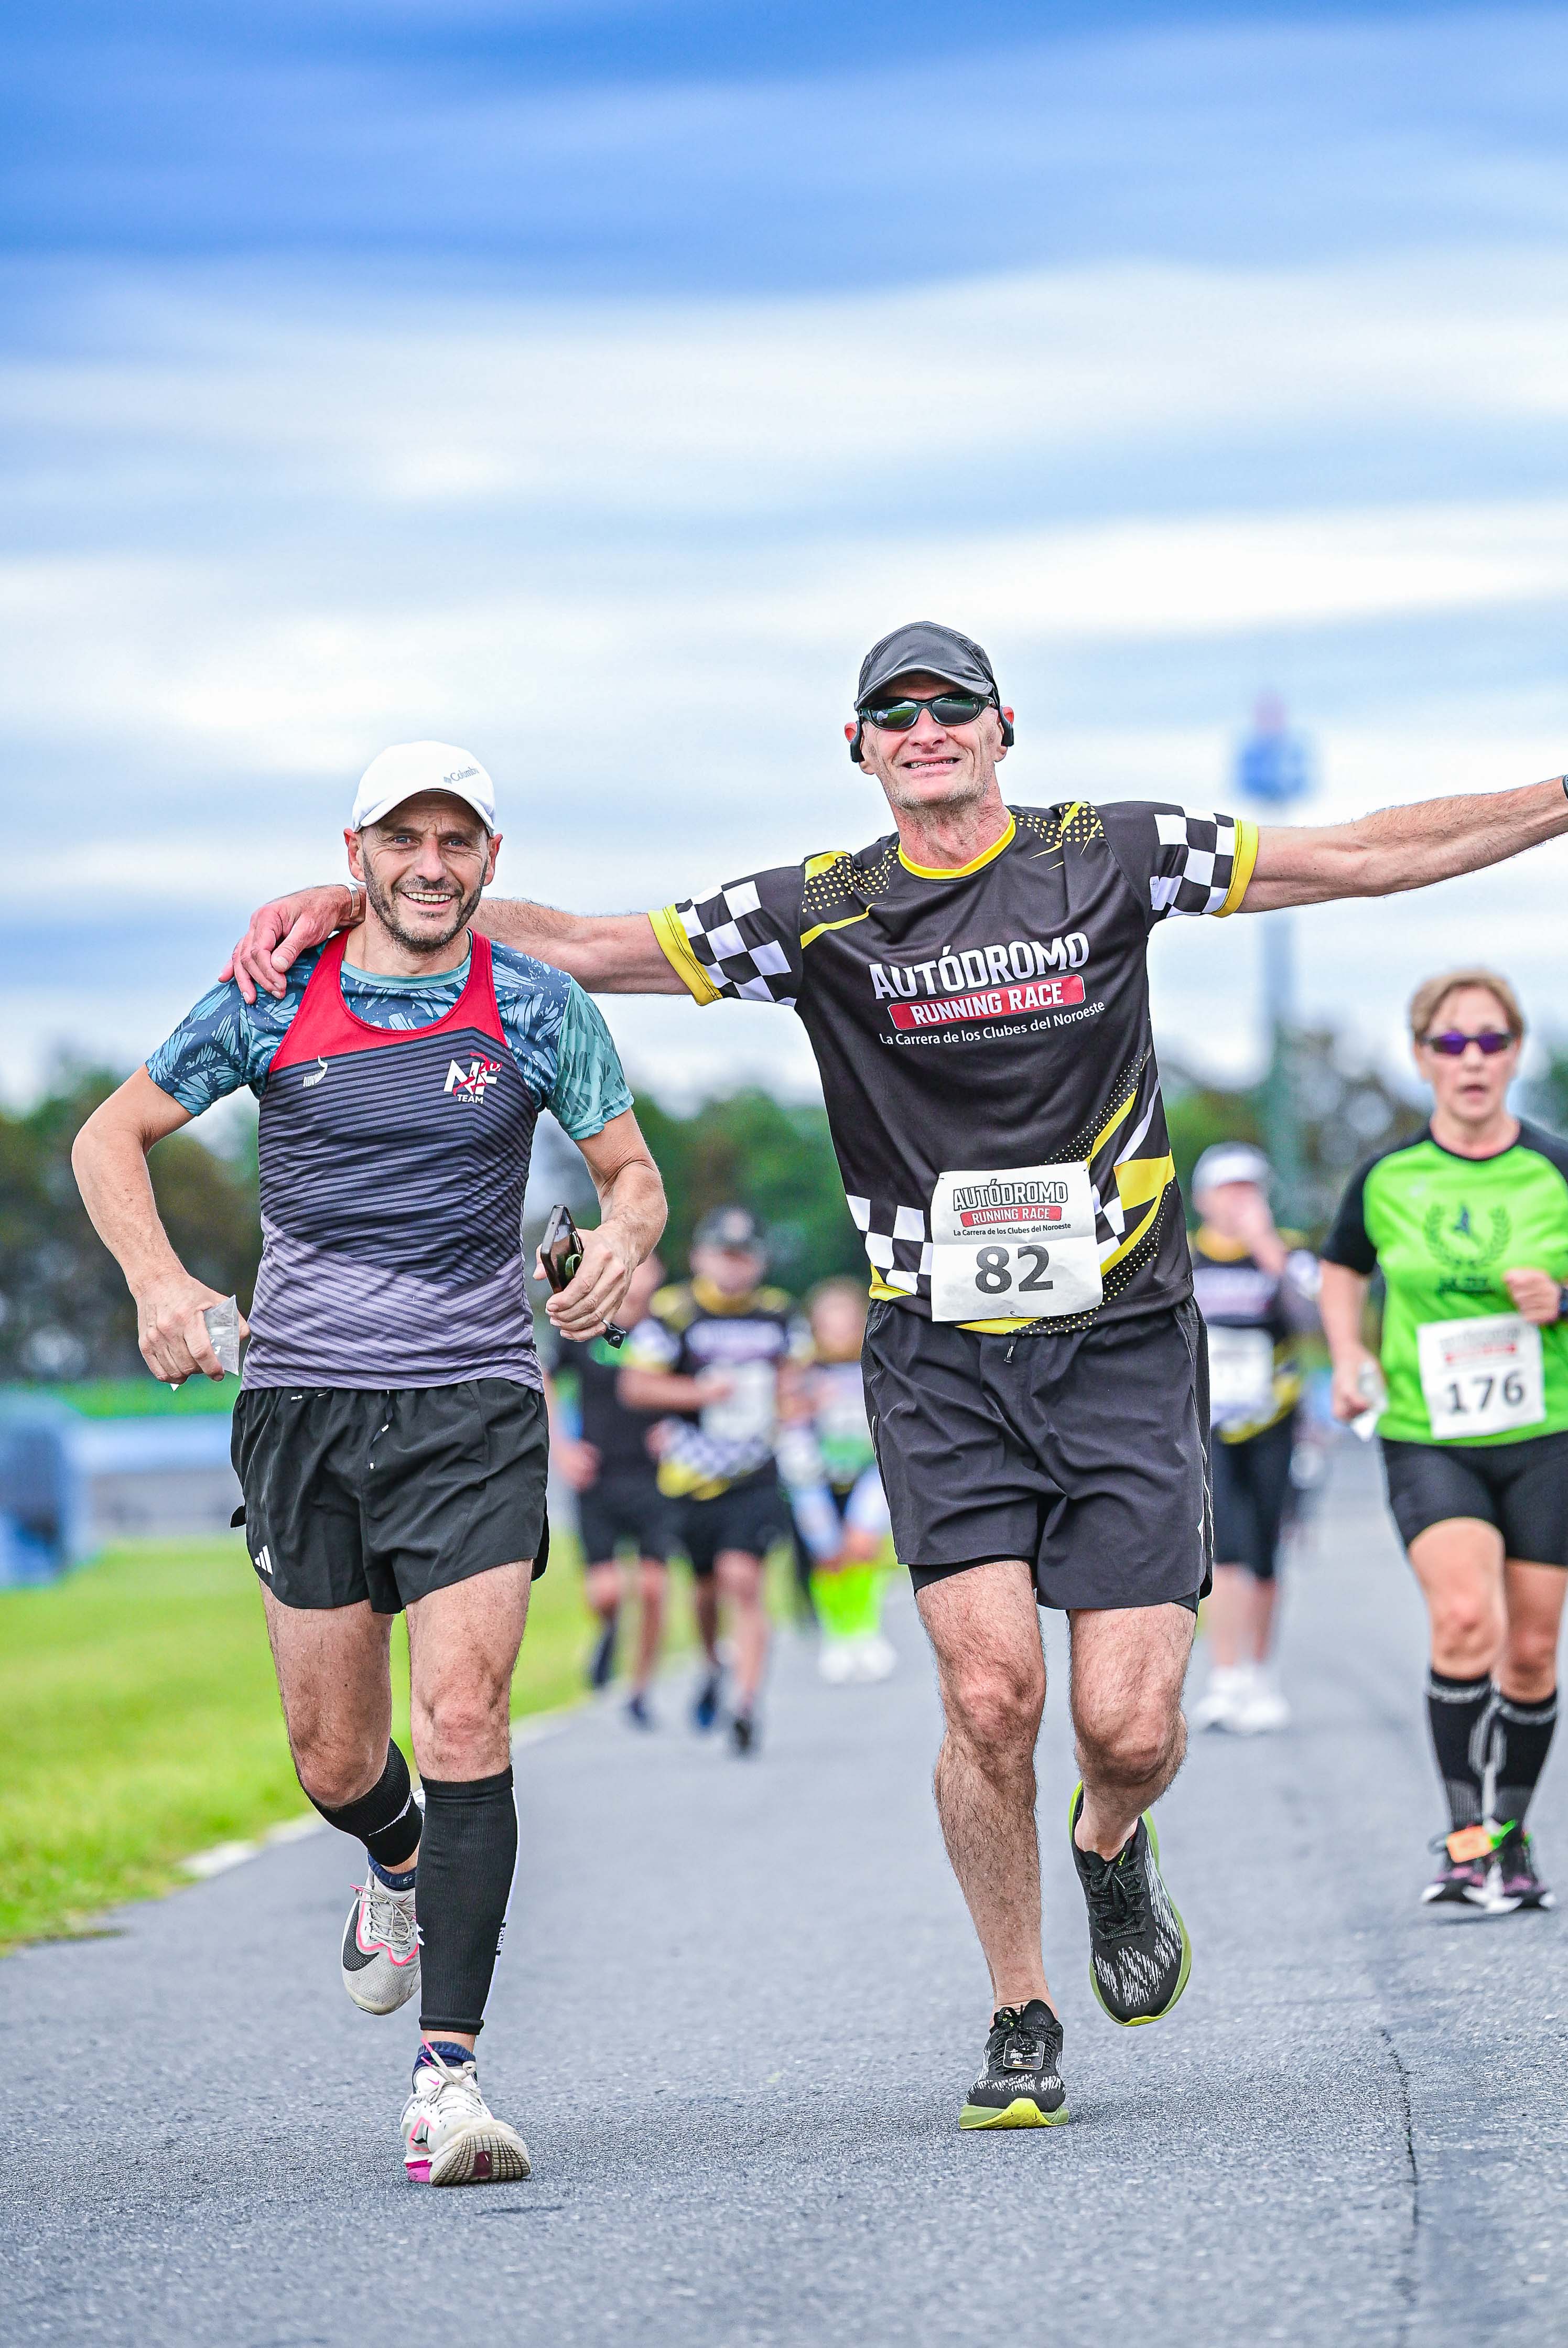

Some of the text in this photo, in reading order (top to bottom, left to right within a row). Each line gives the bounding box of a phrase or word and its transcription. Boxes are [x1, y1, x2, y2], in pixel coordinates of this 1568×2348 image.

[869, 932, 1089, 999] AUTÓDROMO
[879, 1001, 1105, 1045] La Carrera de los Clubes del Noroeste
[910, 982, 1064, 1025] RUNNING RACE
[457, 1094, 483, 1104] TEAM
[953, 1179, 1068, 1211] AUTÓDROMO
[971, 1208, 1051, 1225] RUNNING RACE
[1043, 1223, 1071, 1231] Noroeste
[975, 1245, 1053, 1294] 82
[1446, 1367, 1525, 1414] 176
